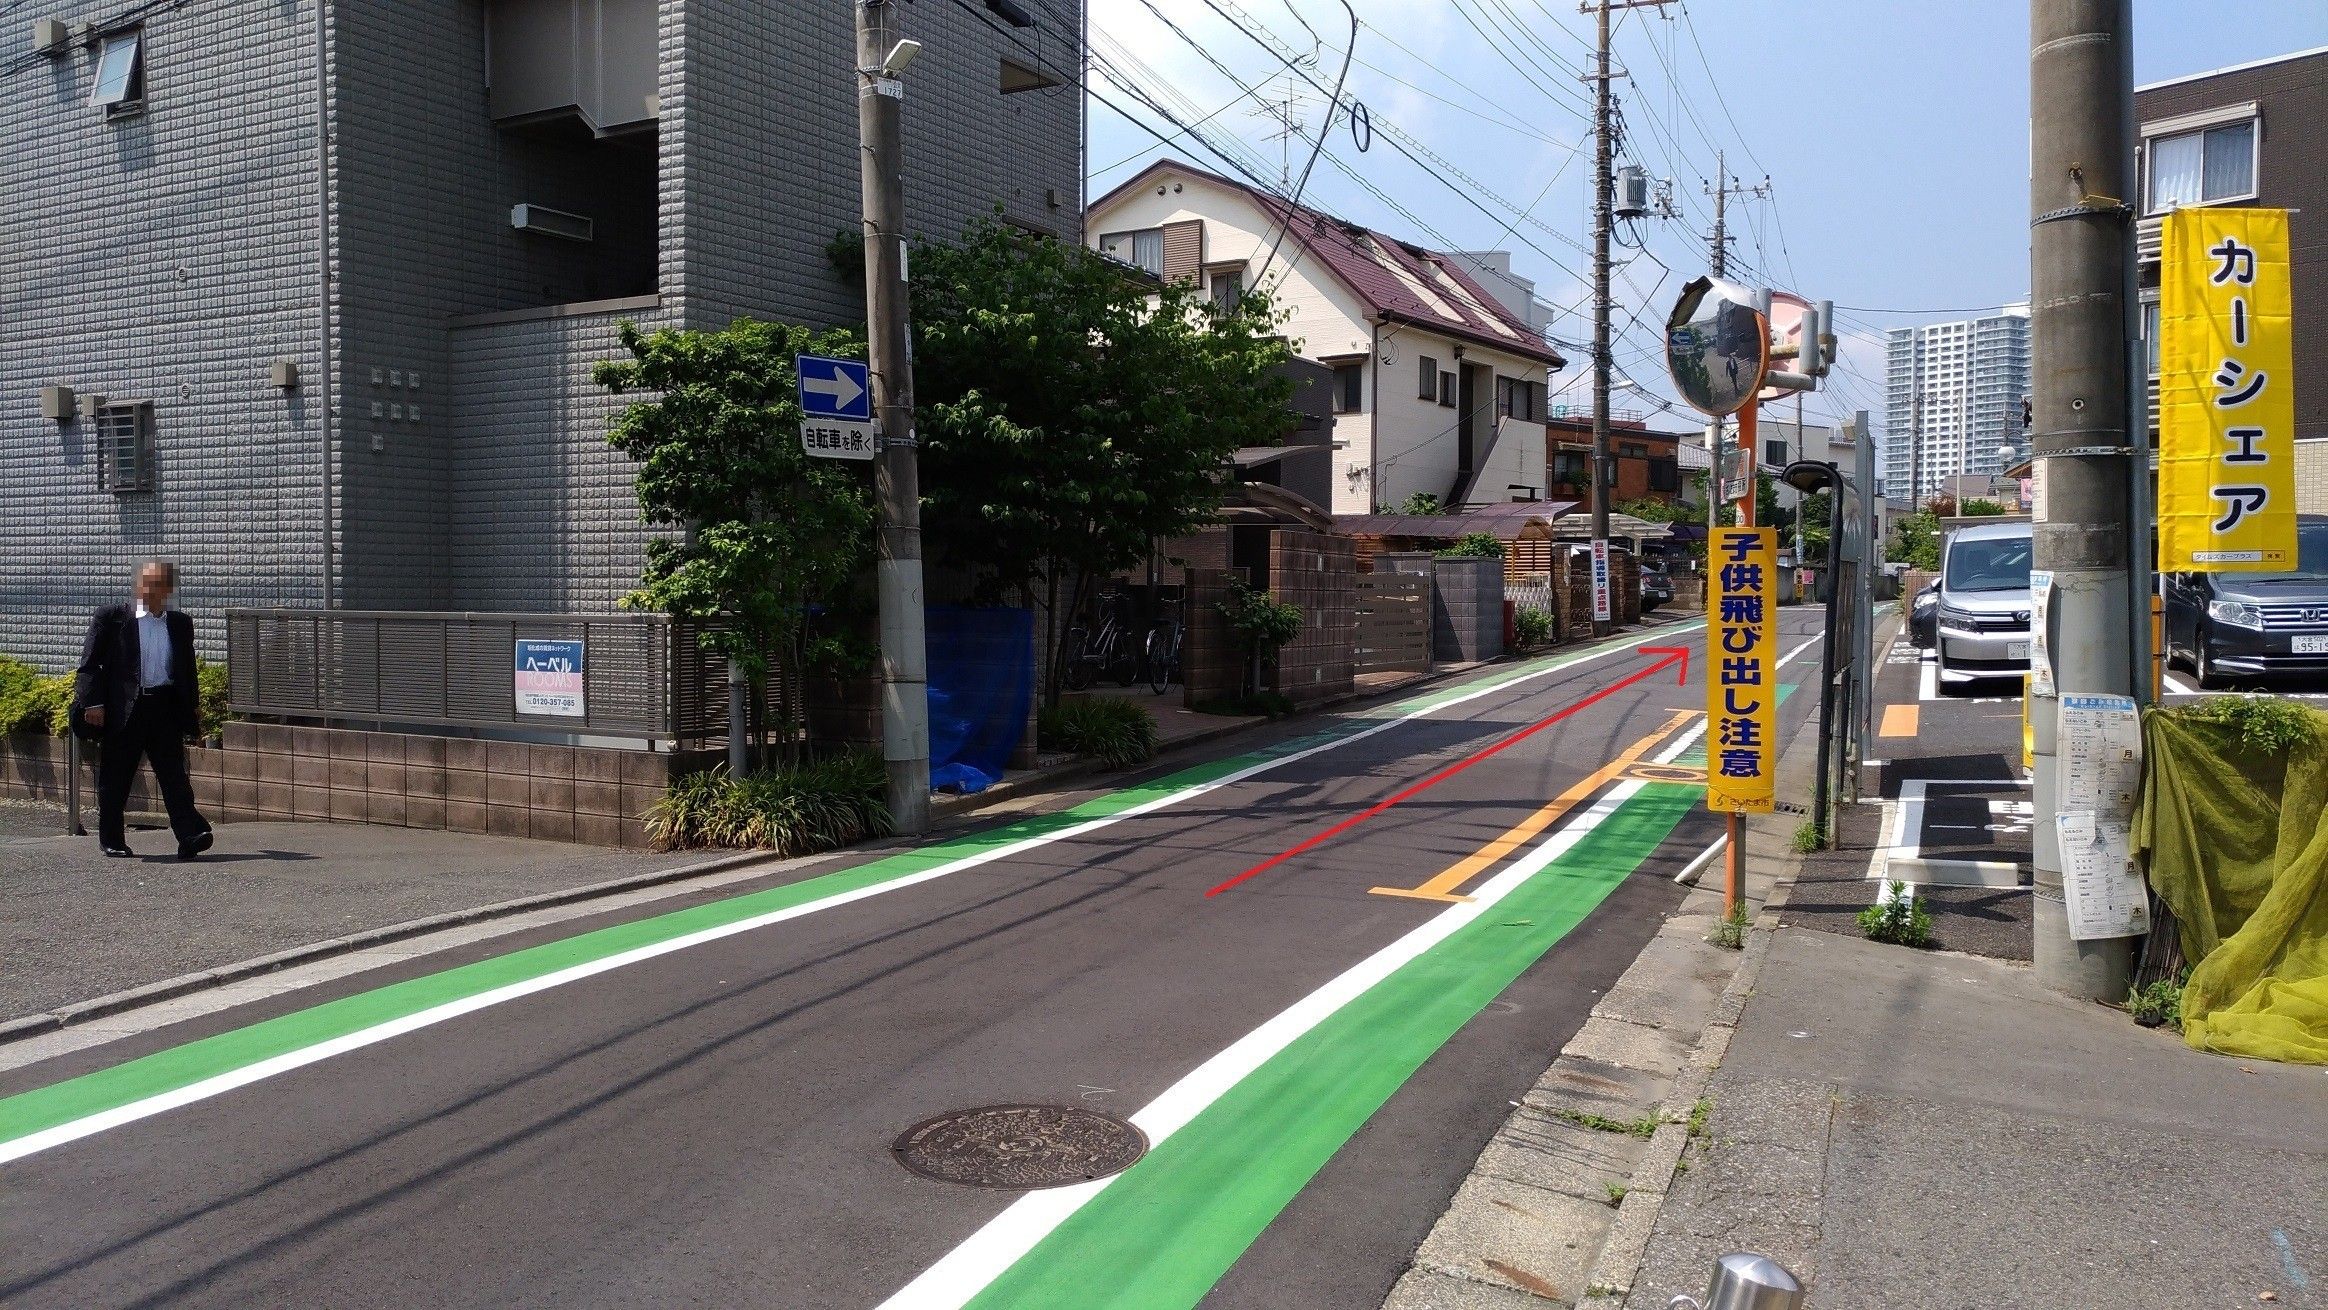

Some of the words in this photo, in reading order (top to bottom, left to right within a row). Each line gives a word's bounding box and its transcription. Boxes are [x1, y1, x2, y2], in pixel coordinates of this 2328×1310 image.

[2209, 238, 2268, 532] カーシェア
[805, 427, 871, 452] 自転車を除く
[1719, 533, 1763, 778] 子供飛び出し注意
[526, 656, 573, 673] ヘーベル
[2124, 750, 2133, 758] 月
[1729, 797, 1770, 807] さいたま市
[2122, 793, 2131, 802] 木
[2132, 906, 2141, 915] 木
